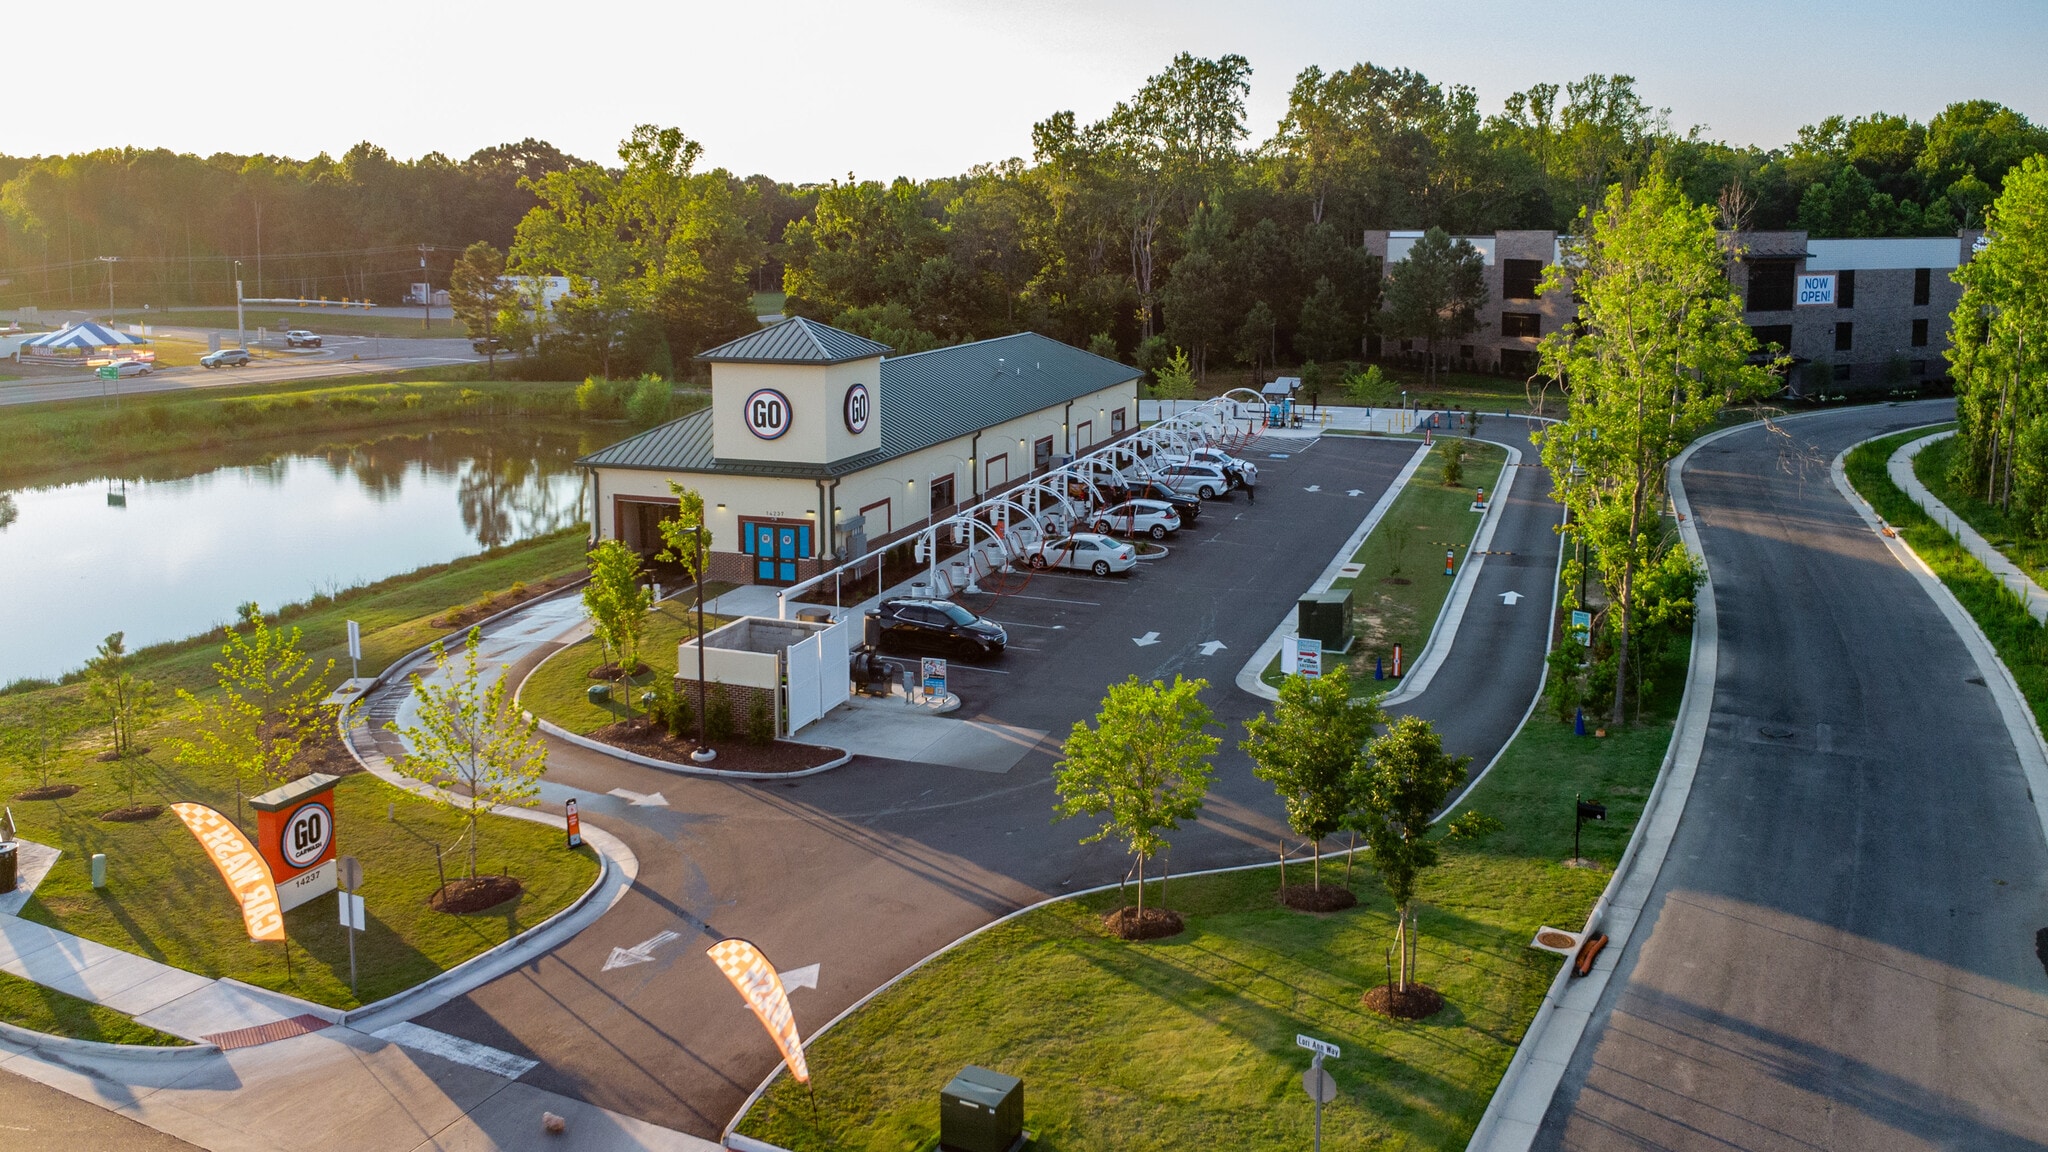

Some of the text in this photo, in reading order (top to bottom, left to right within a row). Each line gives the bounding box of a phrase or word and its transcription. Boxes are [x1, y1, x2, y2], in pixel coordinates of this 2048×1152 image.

[1804, 277, 1829, 289] NOW
[1801, 290, 1831, 302] OPEN!
[753, 399, 782, 428] GO
[852, 393, 866, 423] GO
[294, 813, 321, 850] GO
[296, 871, 320, 888] 14237
[1326, 1045, 1339, 1057] Way
